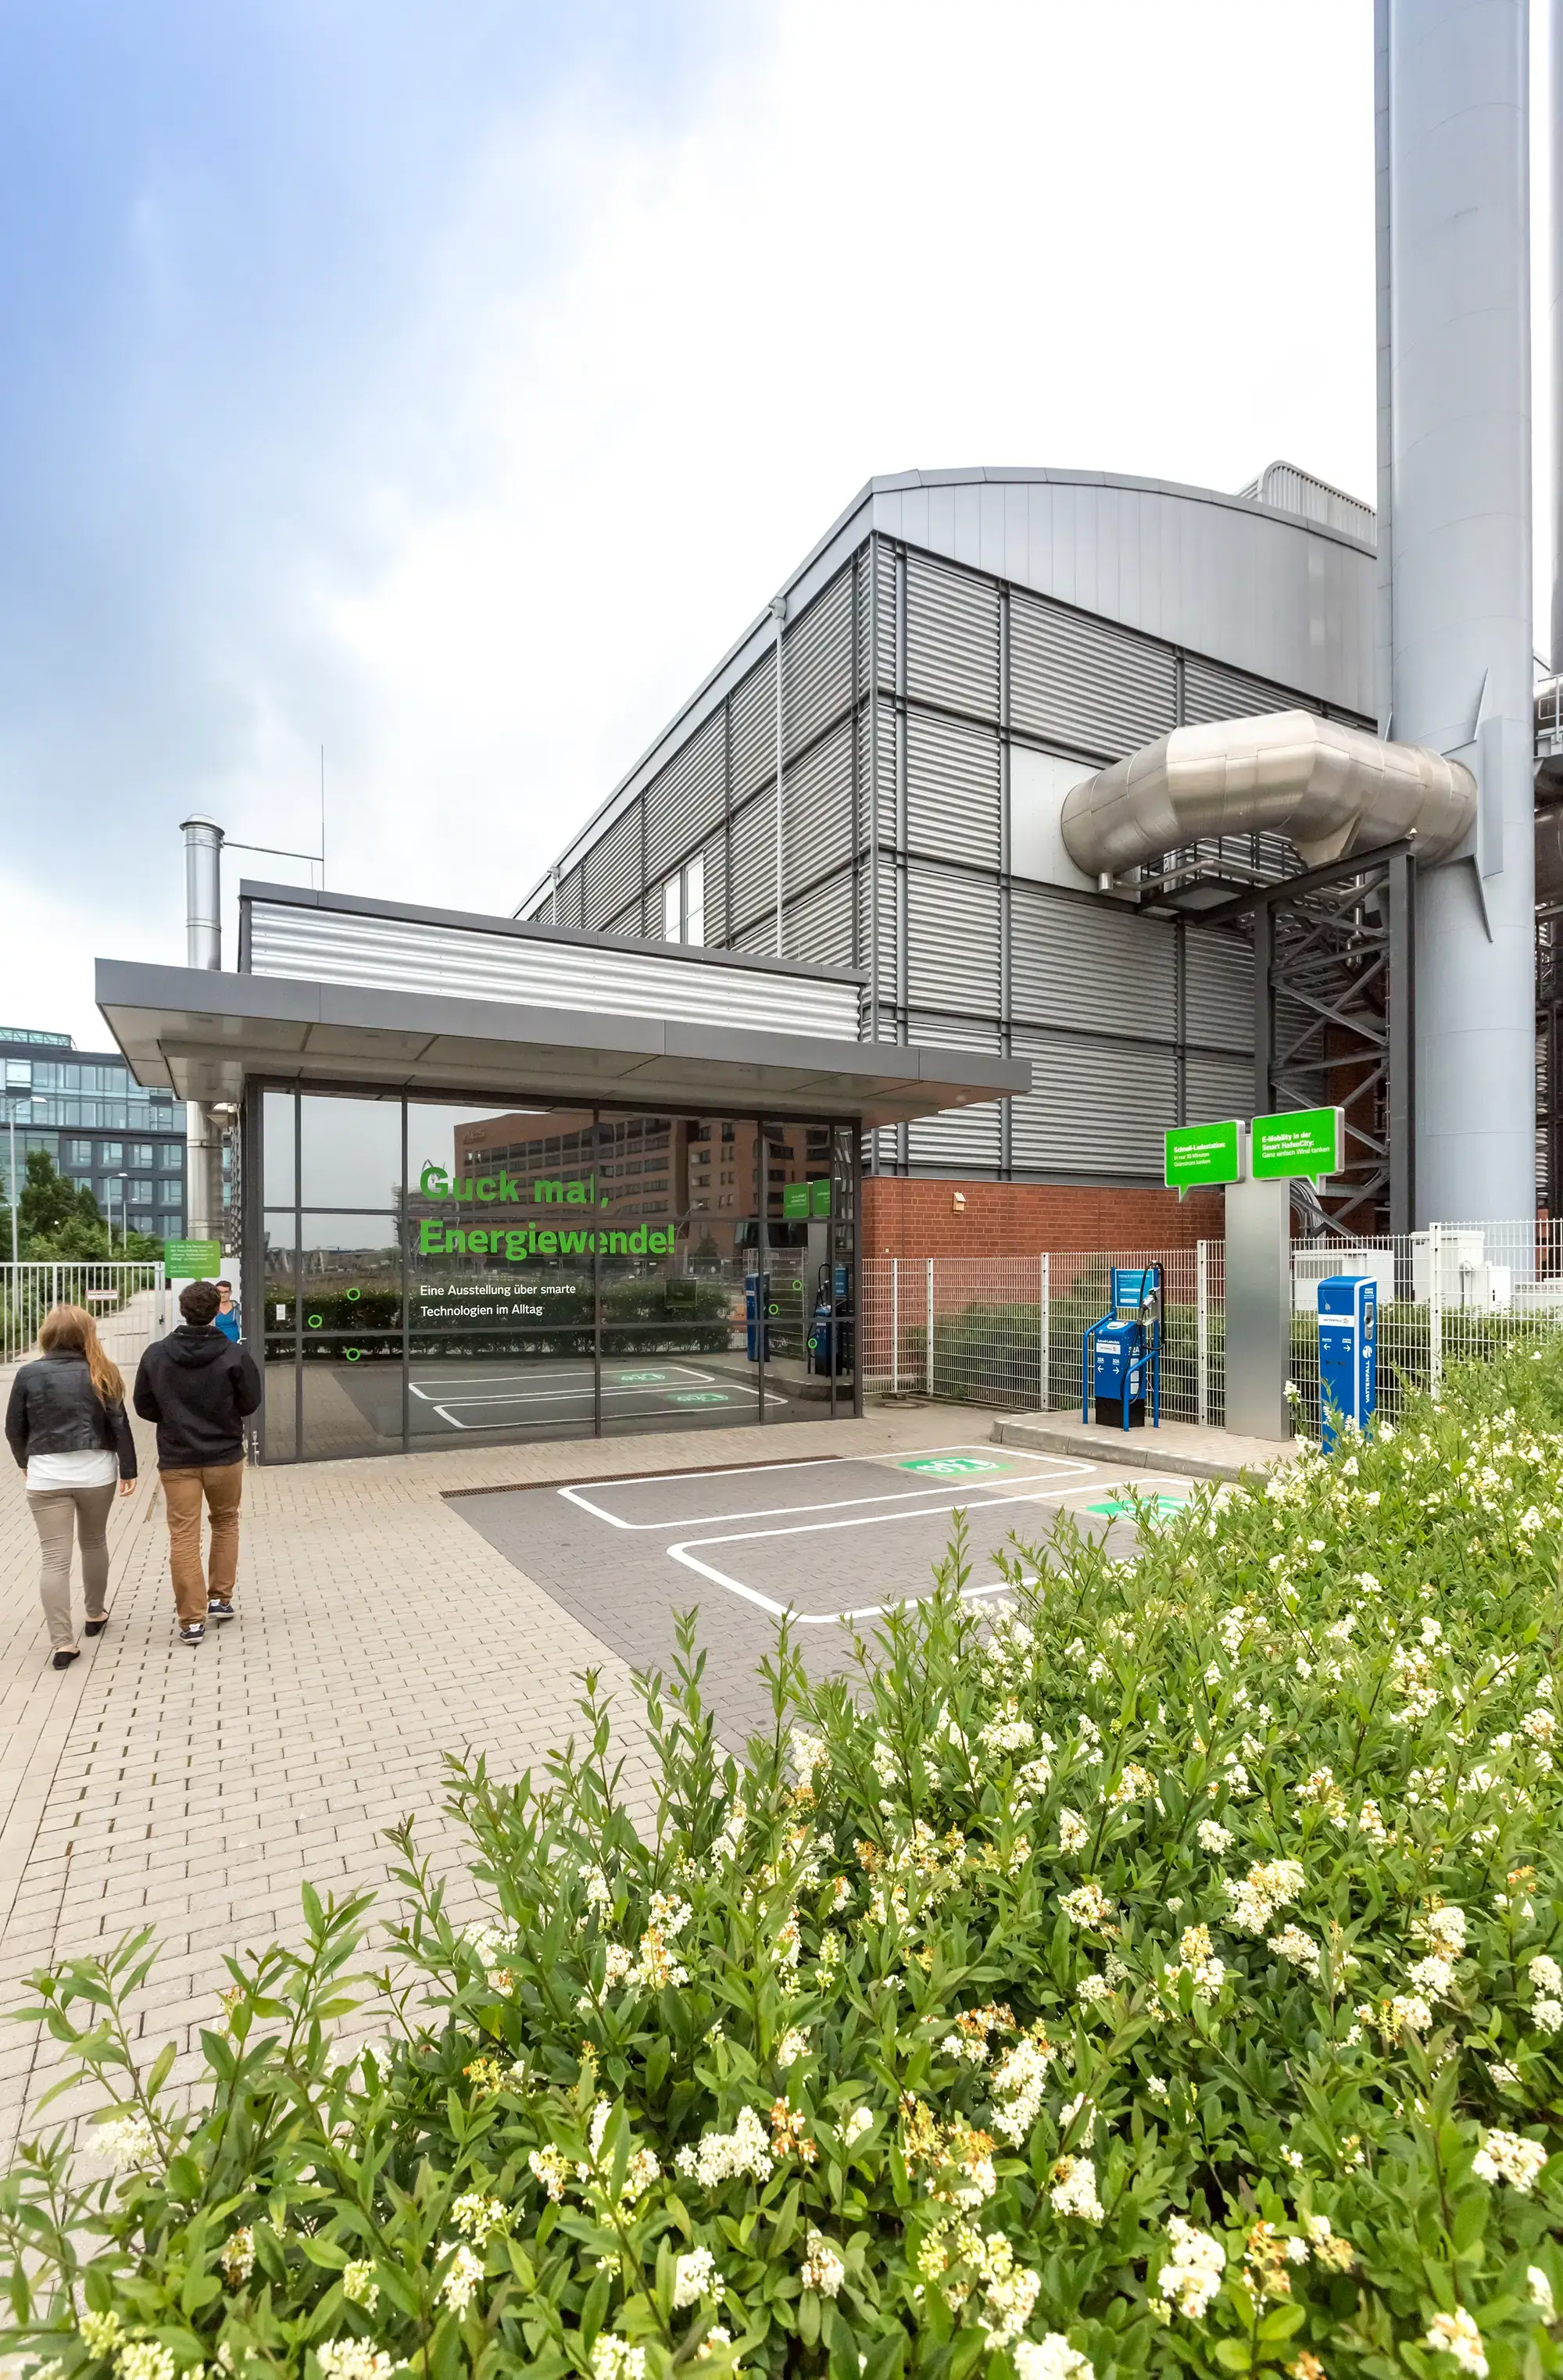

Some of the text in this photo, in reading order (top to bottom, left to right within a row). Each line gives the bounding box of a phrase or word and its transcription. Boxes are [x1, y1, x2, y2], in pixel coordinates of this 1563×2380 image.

[1261, 1134, 1292, 1142] E-Mobility
[1282, 1140, 1314, 1149] HafenCity:
[420, 1167, 609, 1208] Guck mal,
[420, 1219, 675, 1261] Energiewende!
[420, 1284, 576, 1296] Eine Ausstellung über smarte
[420, 1304, 542, 1317] Technologien im Alltag
